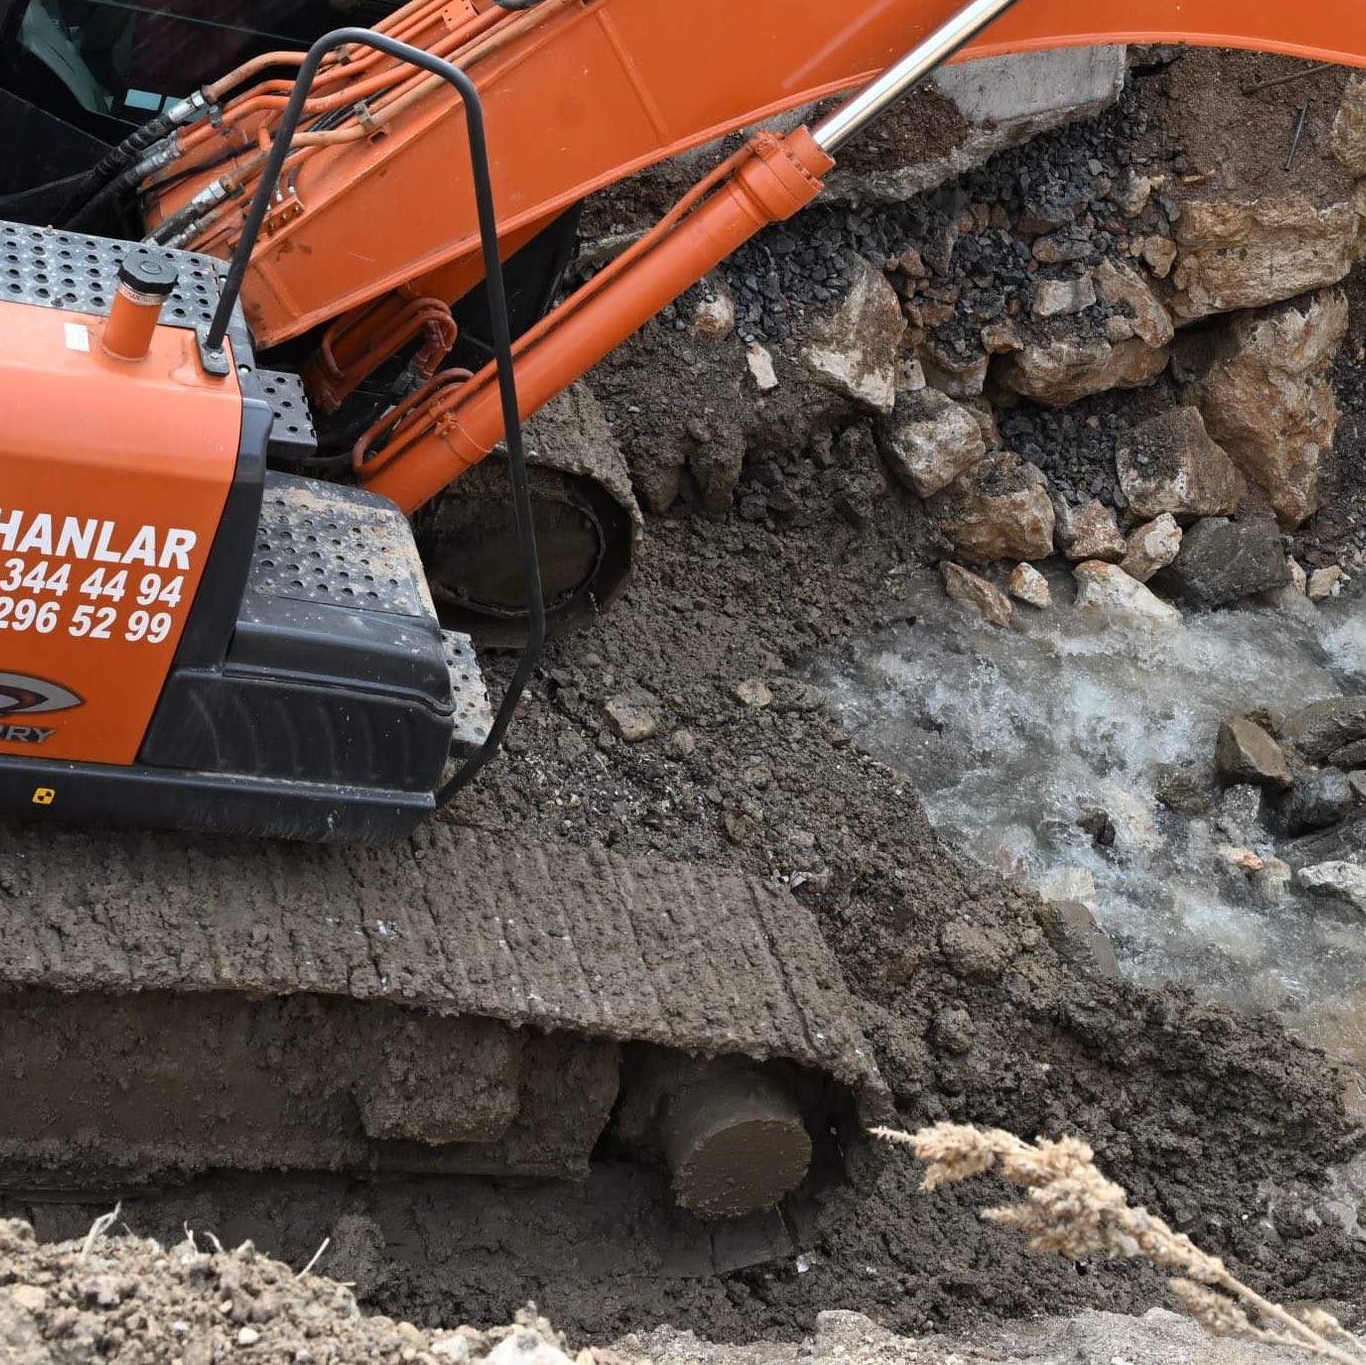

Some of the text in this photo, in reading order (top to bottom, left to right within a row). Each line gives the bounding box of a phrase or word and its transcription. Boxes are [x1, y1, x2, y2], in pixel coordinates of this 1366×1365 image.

[0, 558, 70, 596] 344
[80, 568, 128, 602] 44
[136, 573, 184, 608] 94
[69, 605, 117, 639] 52
[124, 611, 172, 644] 99
